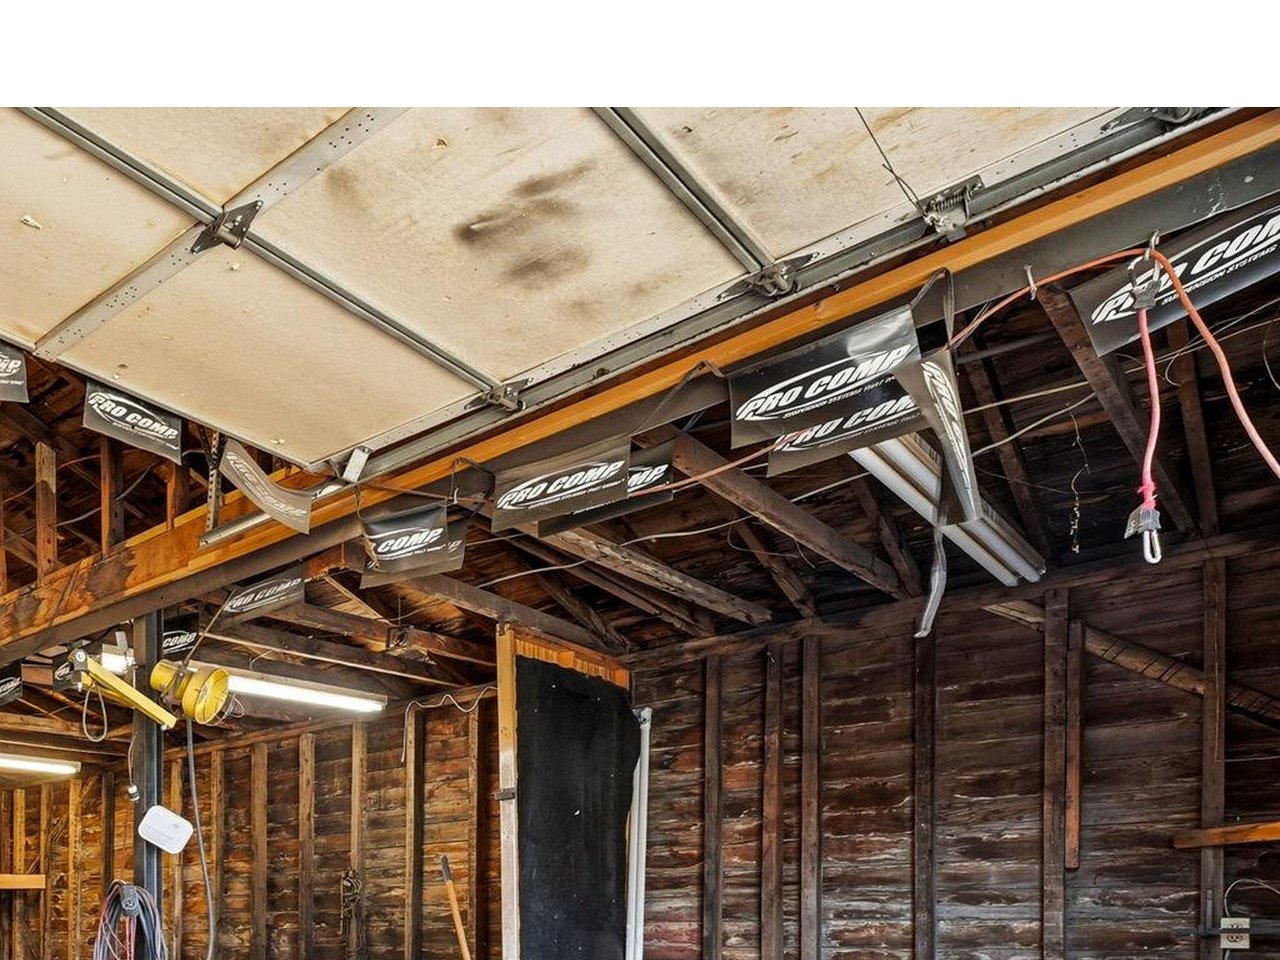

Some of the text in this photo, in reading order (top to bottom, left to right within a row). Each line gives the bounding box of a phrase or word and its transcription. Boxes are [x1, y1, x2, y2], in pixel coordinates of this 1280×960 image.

[1091, 262, 1188, 325] PO
[736, 344, 911, 421] PRO COMP
[87, 395, 128, 418] PRO
[125, 412, 179, 439] COMP
[842, 395, 917, 429] COM
[496, 482, 548, 508] PRO
[546, 460, 625, 493] COMP
[627, 464, 669, 488] MP
[376, 527, 444, 553] COMP
